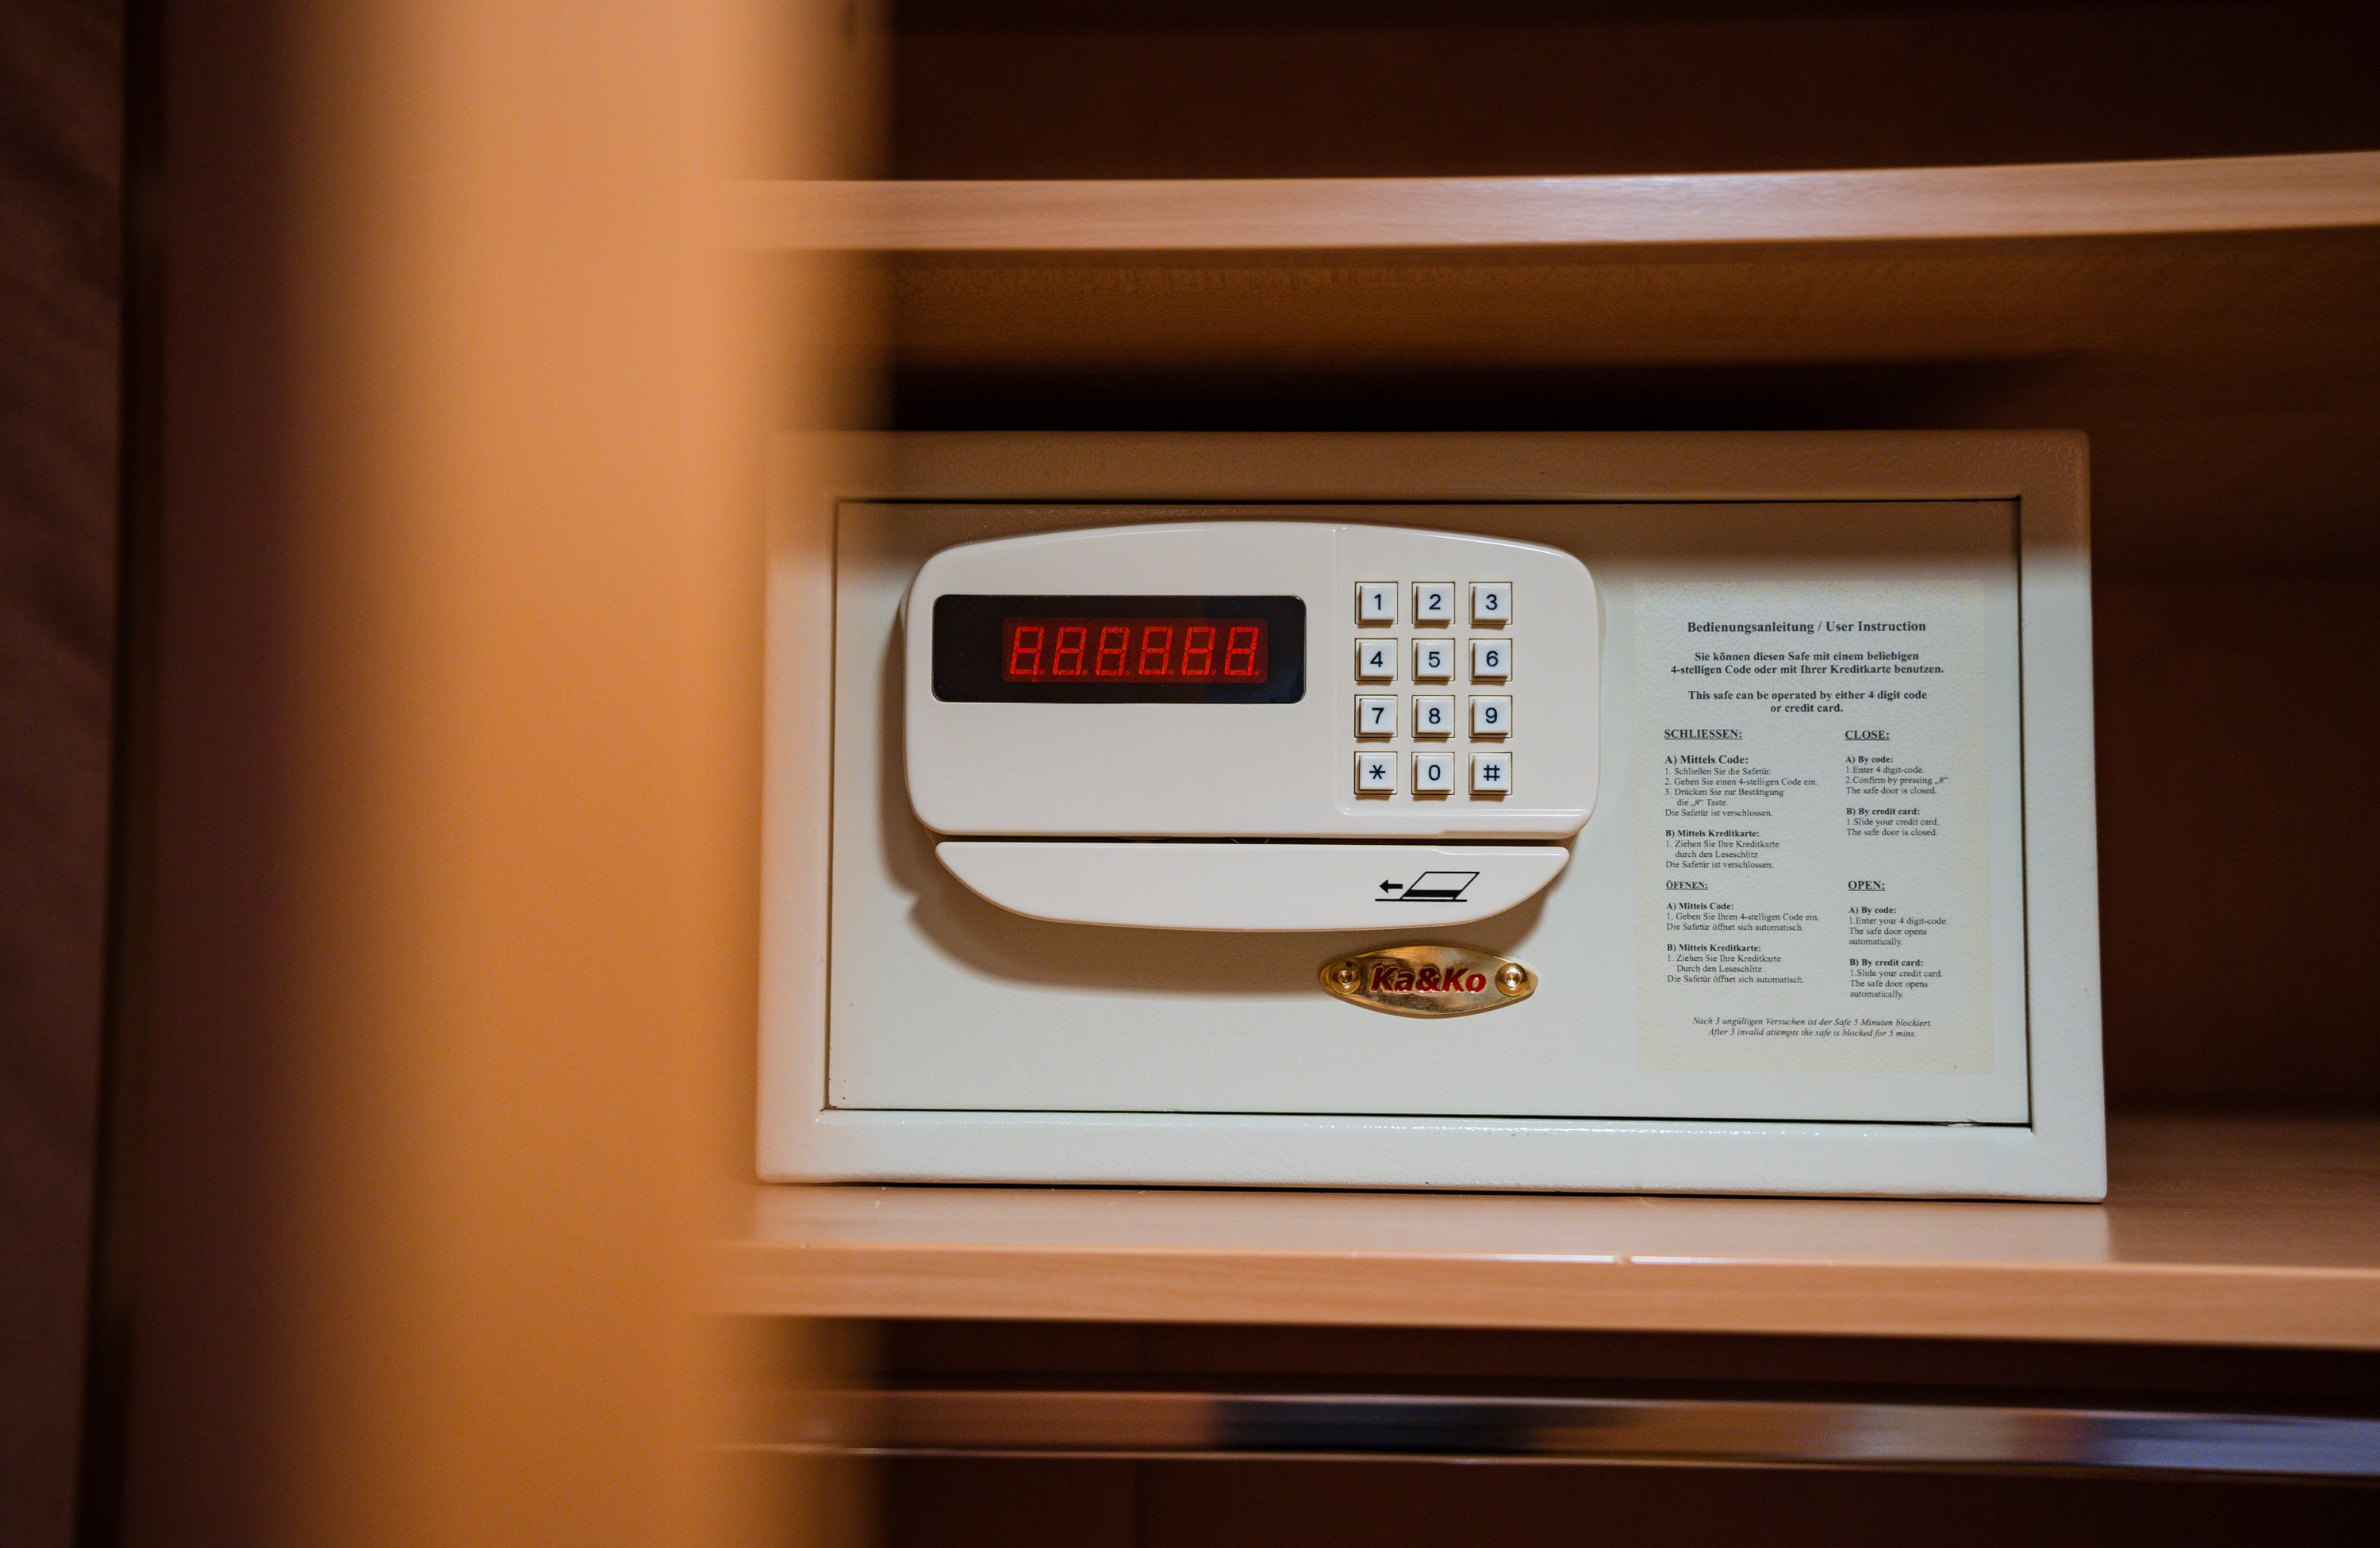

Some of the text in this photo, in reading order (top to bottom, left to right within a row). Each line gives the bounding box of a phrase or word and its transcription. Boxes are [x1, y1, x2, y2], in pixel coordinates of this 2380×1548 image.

[1373, 593, 1498, 611] 1 2 3
[1687, 621, 1814, 635] Bedienungsanleitung
[1825, 620, 1855, 632] User
[1857, 620, 1926, 632] Instruction
[1369, 651, 1499, 668] 4 5 6
[1695, 651, 1919, 663] Sie können diesen Safe mit einem beliebigen
[1670, 664, 1944, 676] 4-stelligen Code oder mit Ihrer Kreditkarte benutzen.
[1687, 690, 1710, 700] This
[1713, 690, 1733, 700] safe
[1756, 690, 1768, 700] be
[1772, 690, 1817, 702] operated
[1819, 690, 1832, 701] by
[1835, 689, 1866, 700] either
[1868, 689, 1875, 699] 4
[1877, 689, 1901, 701] digit
[1903, 689, 1927, 700] code
[1784, 703, 1814, 713] credit
[1817, 703, 1844, 713] card.
[1372, 707, 1498, 724] 7 8 9
[1664, 728, 1743, 740] SCHLIESSEN:
[1844, 729, 1891, 741] CLOSE:
[1664, 755, 1749, 766] A) Mittels Code:
[1844, 755, 1856, 764] A)
[1858, 755, 1869, 765] By
[1428, 764, 1500, 782] 0 #
[1674, 766, 1711, 775] Schließen
[1742, 766, 1772, 775] Safetür.
[1883, 765, 1925, 775] digit-code.
[1664, 777, 1672, 786] 2.
[1674, 777, 1699, 786] Geben
[1701, 777, 1714, 786] Sie
[1738, 778, 1779, 787] 4-stelligen
[1781, 777, 1802, 786] Code
[1803, 777, 1818, 786] ein.
[1664, 787, 1672, 796] 3.
[1674, 787, 1707, 796] Drücken
[1709, 787, 1722, 796] Sie
[1738, 788, 1784, 798] Bestätigung
[1863, 786, 1879, 794] safe
[1880, 786, 1899, 794] door
[1846, 807, 1856, 816] B)
[1858, 807, 1870, 816] By
[1895, 817, 1918, 826] credit
[1920, 817, 1939, 826] card.
[1665, 829, 1676, 838] B)
[1718, 839, 1733, 848] Ihre
[1736, 839, 1779, 848] Kreditkarte
[1715, 850, 1758, 859] Leseschlitz
[1665, 879, 1709, 890] ÖFFNEN:
[1848, 880, 1886, 891] OPEN:
[1666, 901, 1733, 911] A) Mittels Code:
[1848, 906, 1859, 915] A)
[1861, 906, 1872, 916] By
[1666, 922, 1680, 931] Die
[1683, 922, 1710, 931] Safetür
[1712, 922, 1735, 931] öffnet
[1755, 923, 1803, 931] automatisch.
[1906, 916, 1948, 927] digit-code.
[1667, 943, 1676, 952] B)
[1710, 943, 1761, 952] Kreditkarte:
[1848, 937, 1903, 947] automatically.
[1849, 958, 1860, 967] B)
[1861, 958, 1873, 968] By
[1370, 965, 1487, 993] Ka&Ko
[1715, 1016, 1720, 1025] 3
[1722, 1016, 1764, 1027] ungültigen
[1818, 1017, 1833, 1026] der
[1834, 1017, 1852, 1028] Safe
[1861, 1018, 1894, 1027] Minuten
[1895, 1018, 1933, 1027] blockiert.
[1708, 1027, 1728, 1037] After
[1766, 1029, 1799, 1038] attempts
[1801, 1028, 1814, 1036] the
[1815, 1028, 1832, 1038] safe
[1842, 1028, 1873, 1037] blocked
[1875, 1028, 1887, 1038] for
